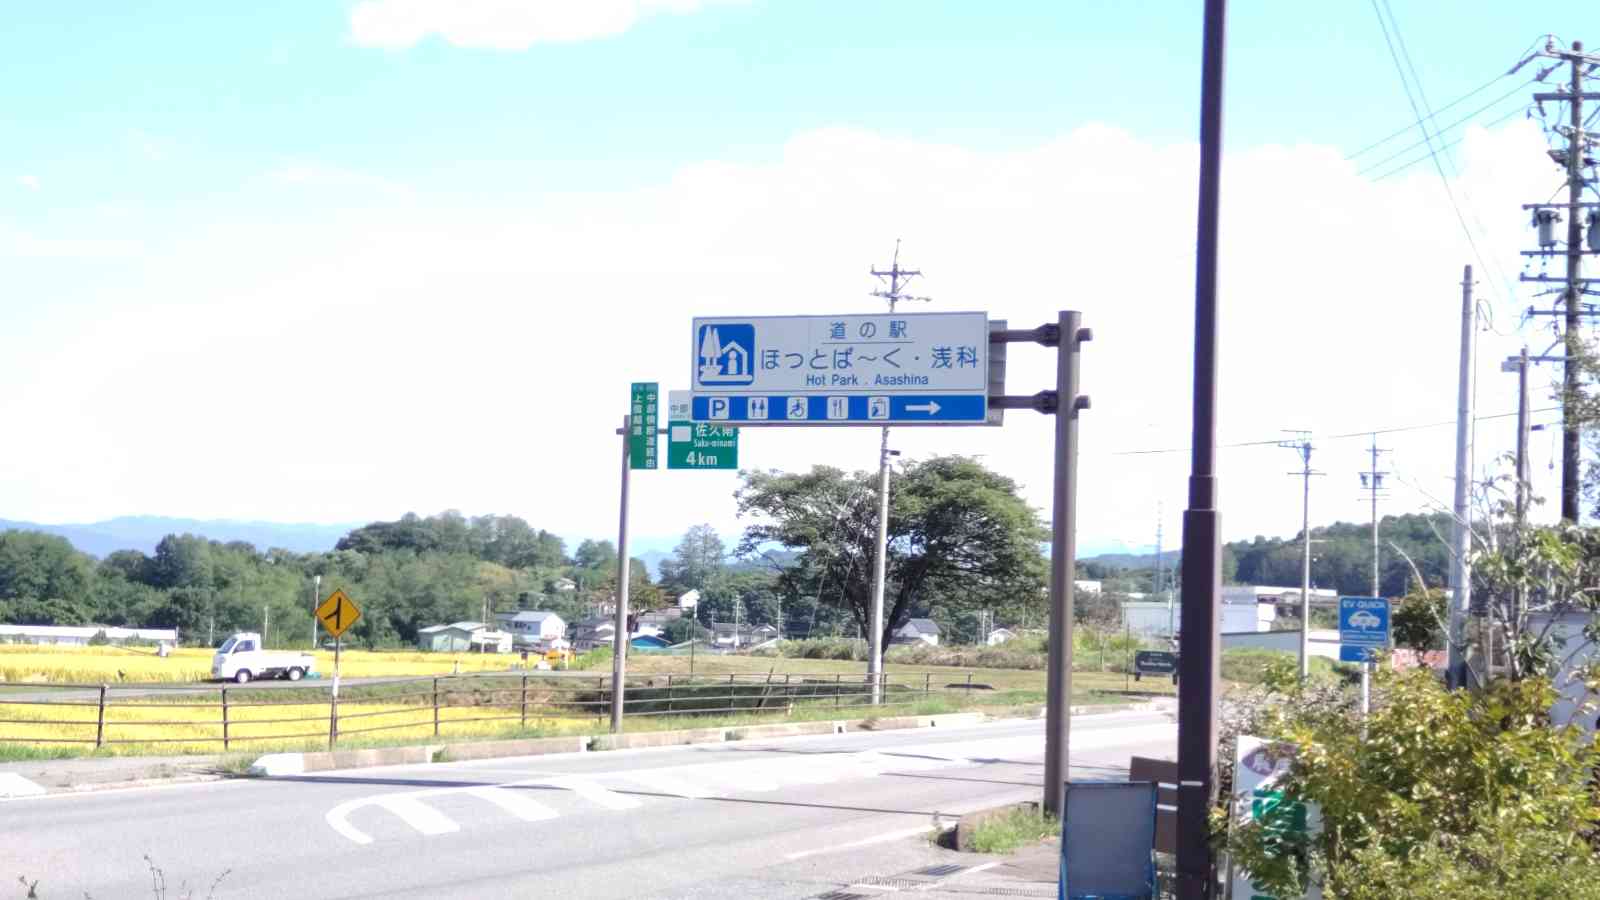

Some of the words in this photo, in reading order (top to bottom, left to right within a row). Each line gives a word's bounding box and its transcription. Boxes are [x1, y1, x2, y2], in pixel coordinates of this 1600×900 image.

[830, 320, 907, 339] 道の駅
[806, 374, 826, 386] Hot
[831, 374, 858, 385] Park
[875, 373, 929, 385] Asashina
[712, 399, 726, 417] P
